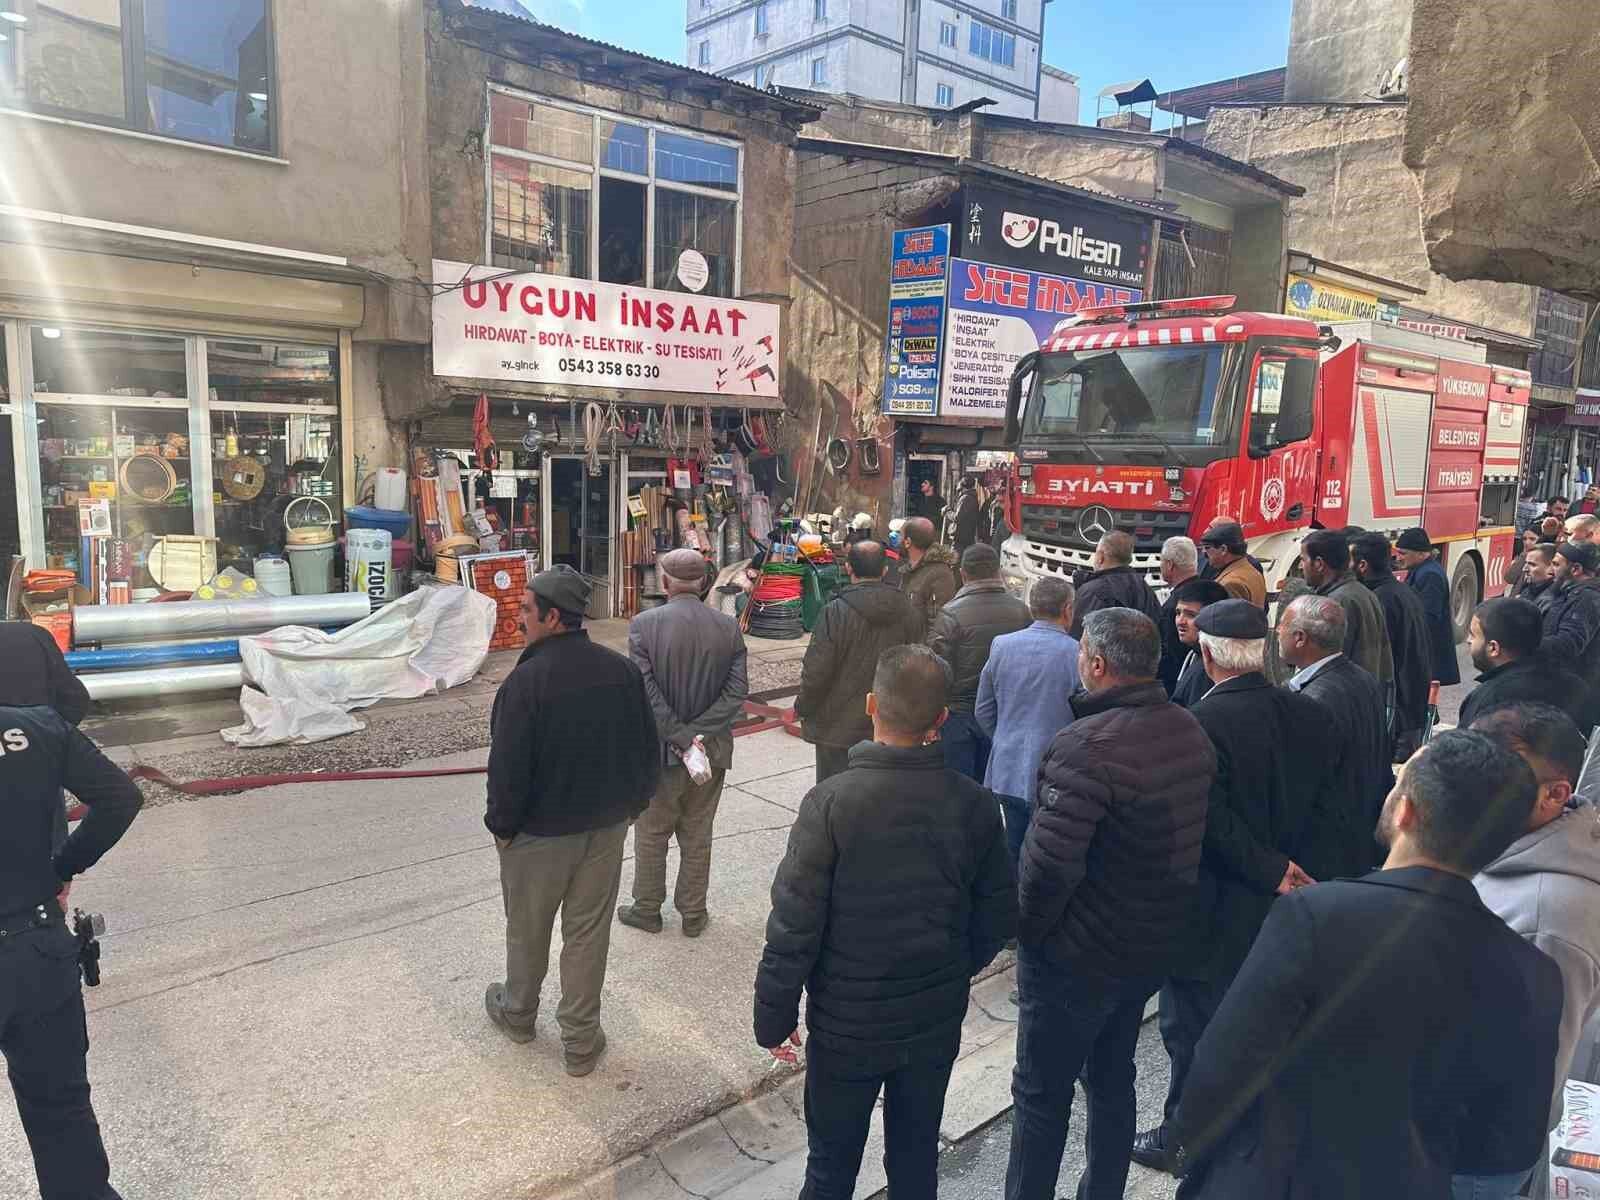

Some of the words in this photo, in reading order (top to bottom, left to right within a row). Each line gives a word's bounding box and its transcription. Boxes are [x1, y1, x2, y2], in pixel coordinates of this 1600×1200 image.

[1039, 220, 1121, 267] Polisan
[1083, 265, 1102, 276] KALE
[1102, 268, 1119, 279] YAPI
[462, 277, 596, 322] UYGUN
[621, 292, 747, 336] İNŞAAT
[957, 313, 1000, 327] HIRDAVAT
[464, 323, 528, 344] HIRDAVAT
[538, 331, 574, 348] BOYA
[655, 343, 670, 356] SU
[954, 350, 978, 360] BOYA
[558, 358, 594, 374] 0543
[597, 361, 622, 376] 358
[899, 365, 936, 379] Polisan
[1442, 376, 1486, 398] YÜKSEKOVA
[949, 398, 1006, 409] MALZEMELER
[1439, 428, 1480, 446] BELEDİYESİ
[1438, 468, 1473, 486] İTFAİYESİ
[1326, 480, 1341, 495] 112
[368, 561, 385, 614] IZOCA
[0, 728, 30, 757] S
